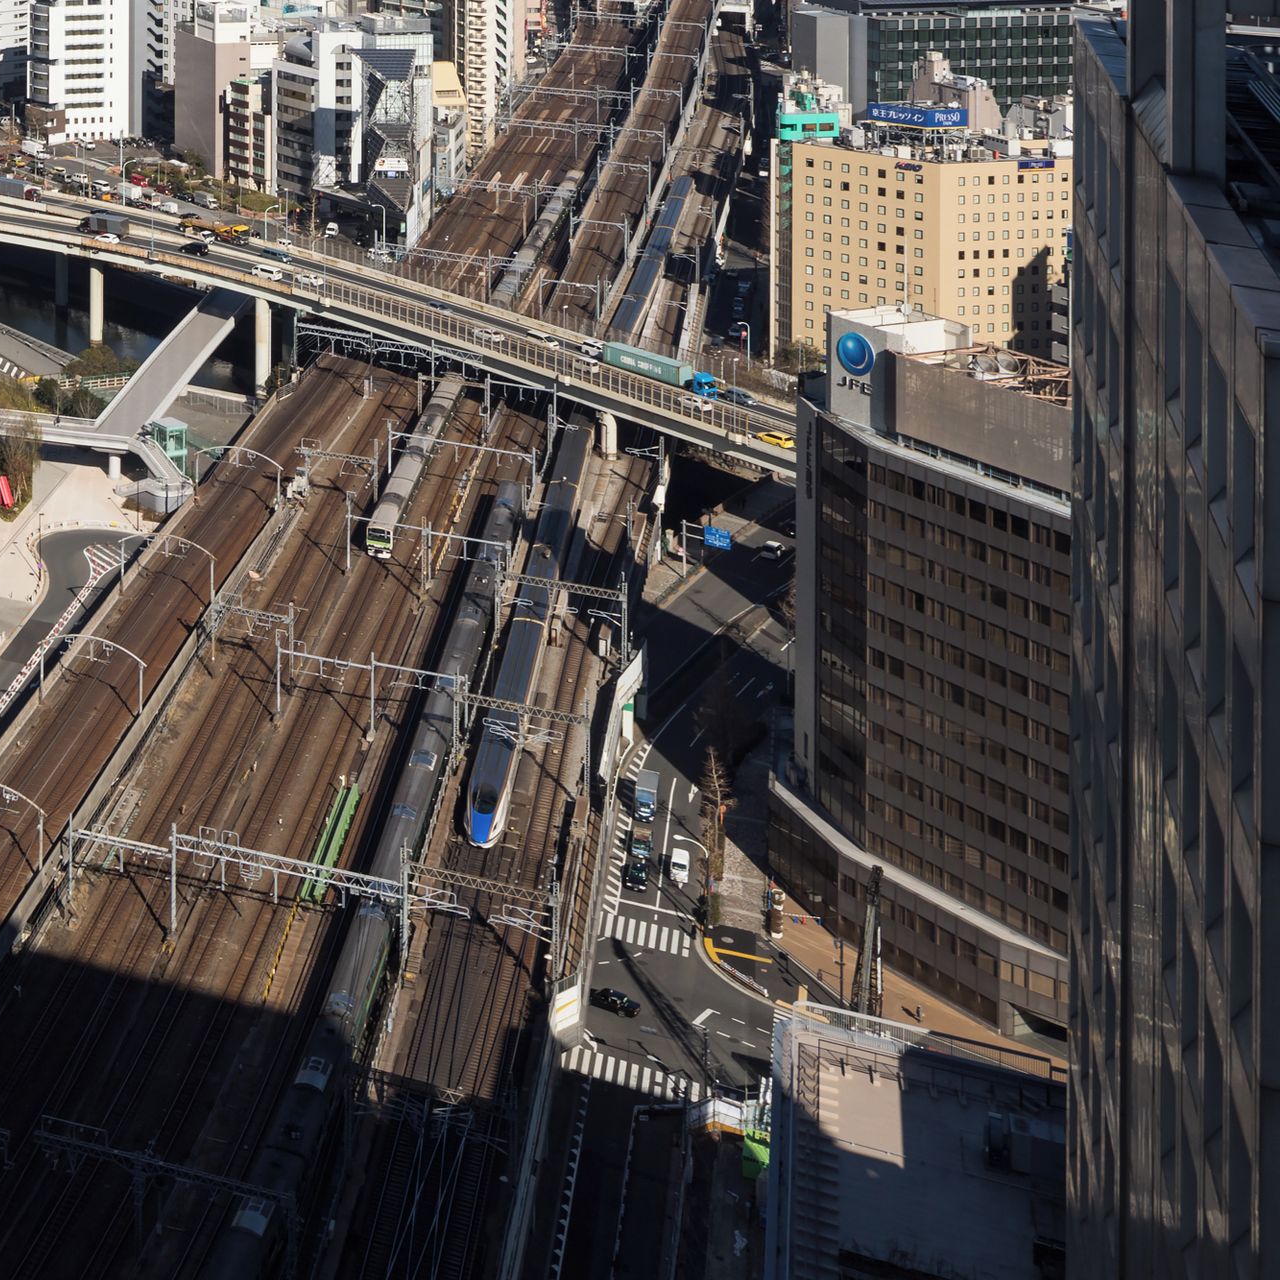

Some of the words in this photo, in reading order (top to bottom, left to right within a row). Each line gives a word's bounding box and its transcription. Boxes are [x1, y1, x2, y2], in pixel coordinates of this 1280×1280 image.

[872, 108, 925, 122] 京王プレッソイン
[935, 112, 960, 123] PRESSO
[836, 375, 873, 397] JFE
